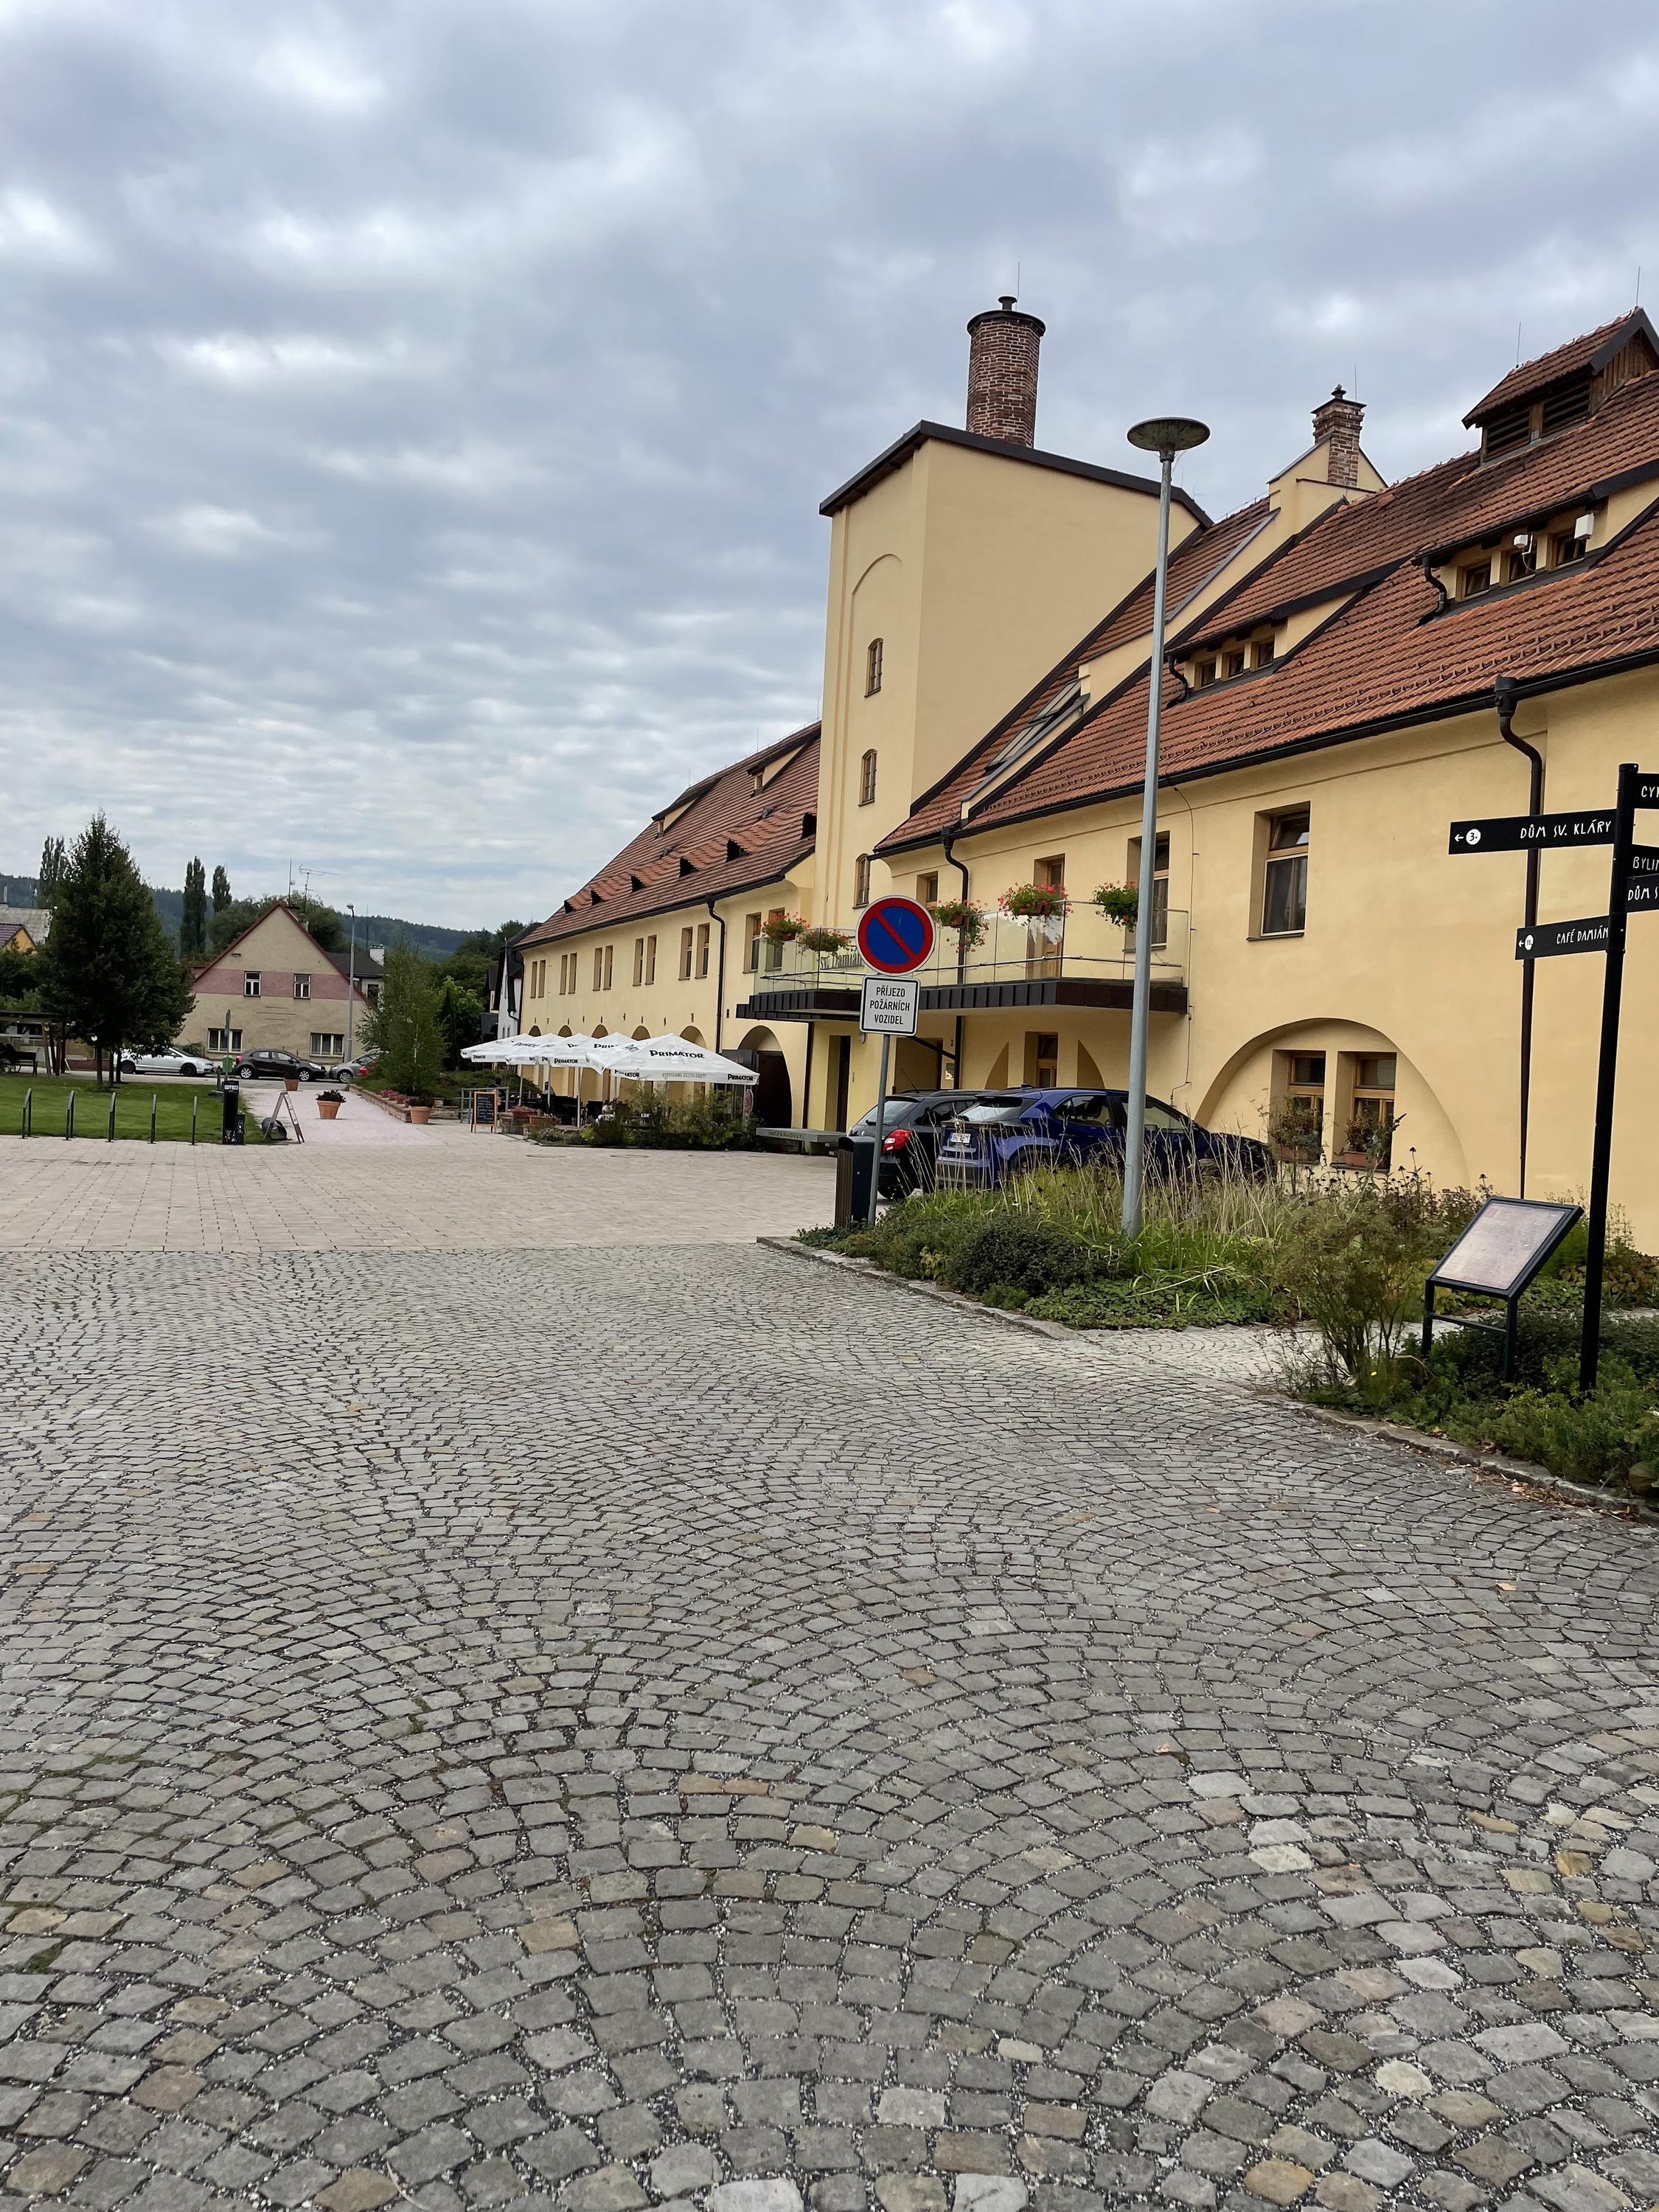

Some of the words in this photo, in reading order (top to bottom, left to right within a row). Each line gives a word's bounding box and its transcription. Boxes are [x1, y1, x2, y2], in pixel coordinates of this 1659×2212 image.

[1520, 824, 1546, 839] DŮM
[1554, 824, 1568, 838] SV.
[1573, 819, 1612, 835] KLÁRY
[1628, 885, 1649, 901] DŮM
[1557, 928, 1576, 945] CAFÉ
[1577, 925, 1609, 942] DAMIÁN
[876, 984, 905, 997] PŘÍJEZD
[870, 998, 910, 1012] POŽÁRNÍCH
[874, 1014, 904, 1024] VOZIDEL
[650, 1050, 705, 1059] PRIMATOR
[727, 1074, 754, 1082] PRIMATOR
